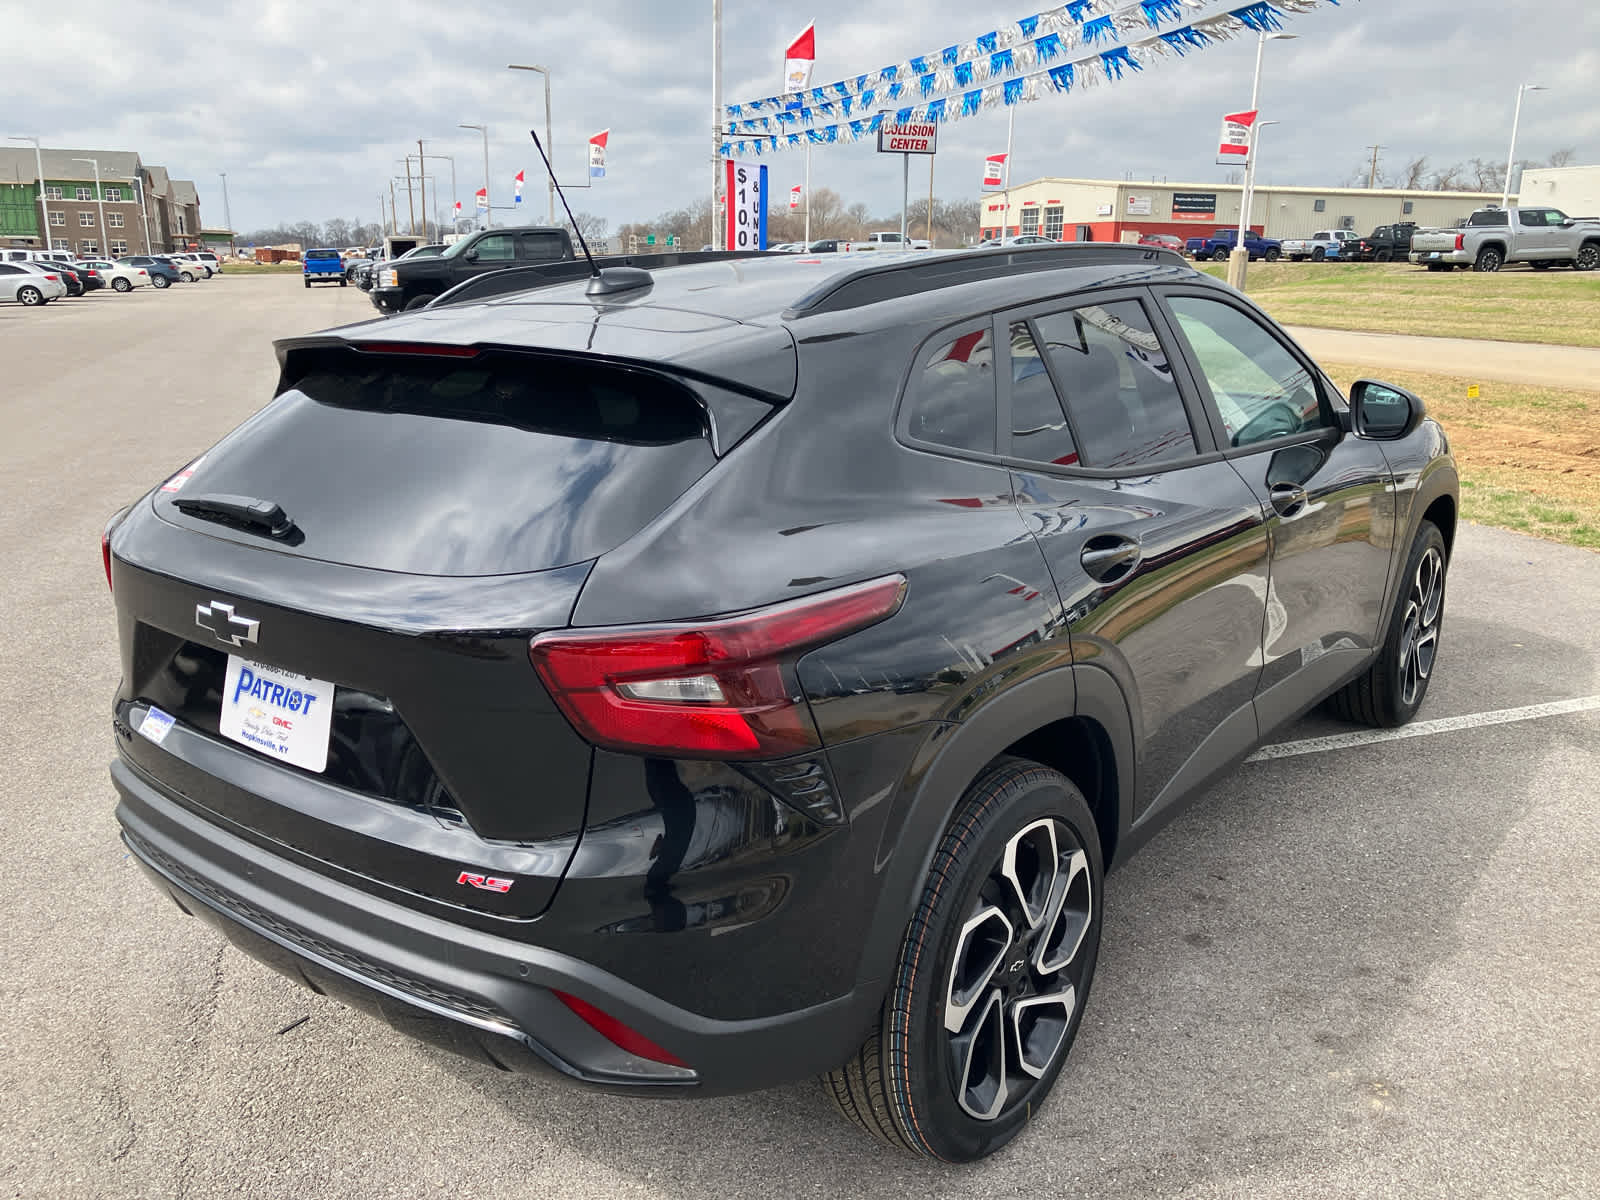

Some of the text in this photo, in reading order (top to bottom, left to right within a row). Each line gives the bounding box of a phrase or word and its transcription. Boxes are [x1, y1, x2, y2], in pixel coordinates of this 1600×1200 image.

[890, 137, 928, 151] CENTER
[752, 181, 759, 193] &
[232, 666, 317, 716] PATRIOT
[272, 716, 293, 731] GMC
[241, 728, 278, 752] Hopkinsville,
[278, 744, 289, 754] KY
[457, 871, 515, 893] RS
